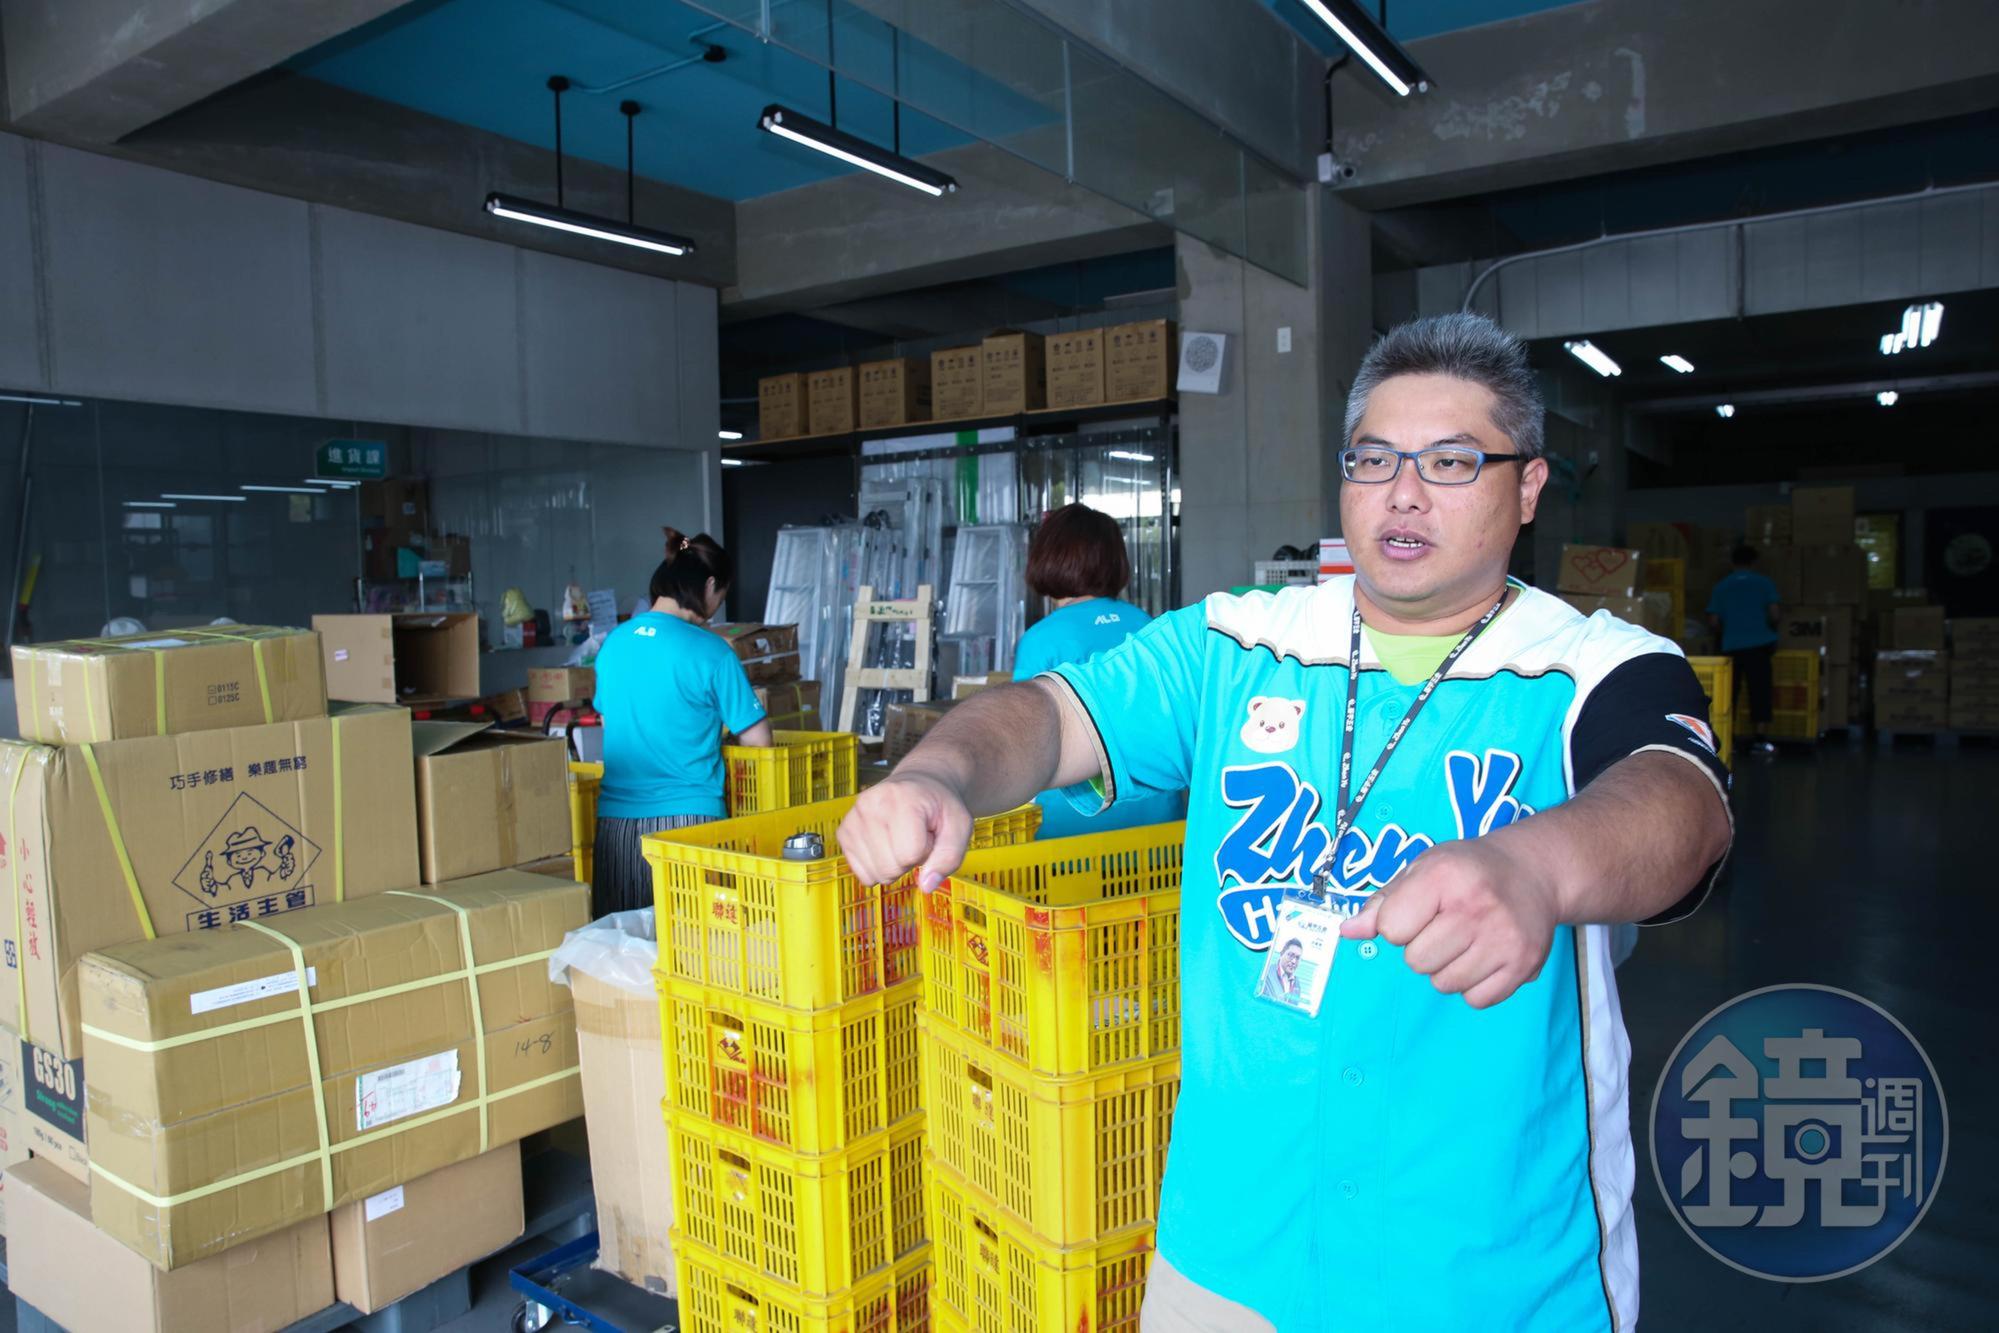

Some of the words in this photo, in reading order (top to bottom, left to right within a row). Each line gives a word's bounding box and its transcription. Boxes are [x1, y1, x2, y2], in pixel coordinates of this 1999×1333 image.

[1789, 621, 1822, 637] 3M
[169, 768, 234, 790] 巧手修繕
[1214, 761, 1437, 890] Zhen
[32, 1046, 77, 1101] GS30
